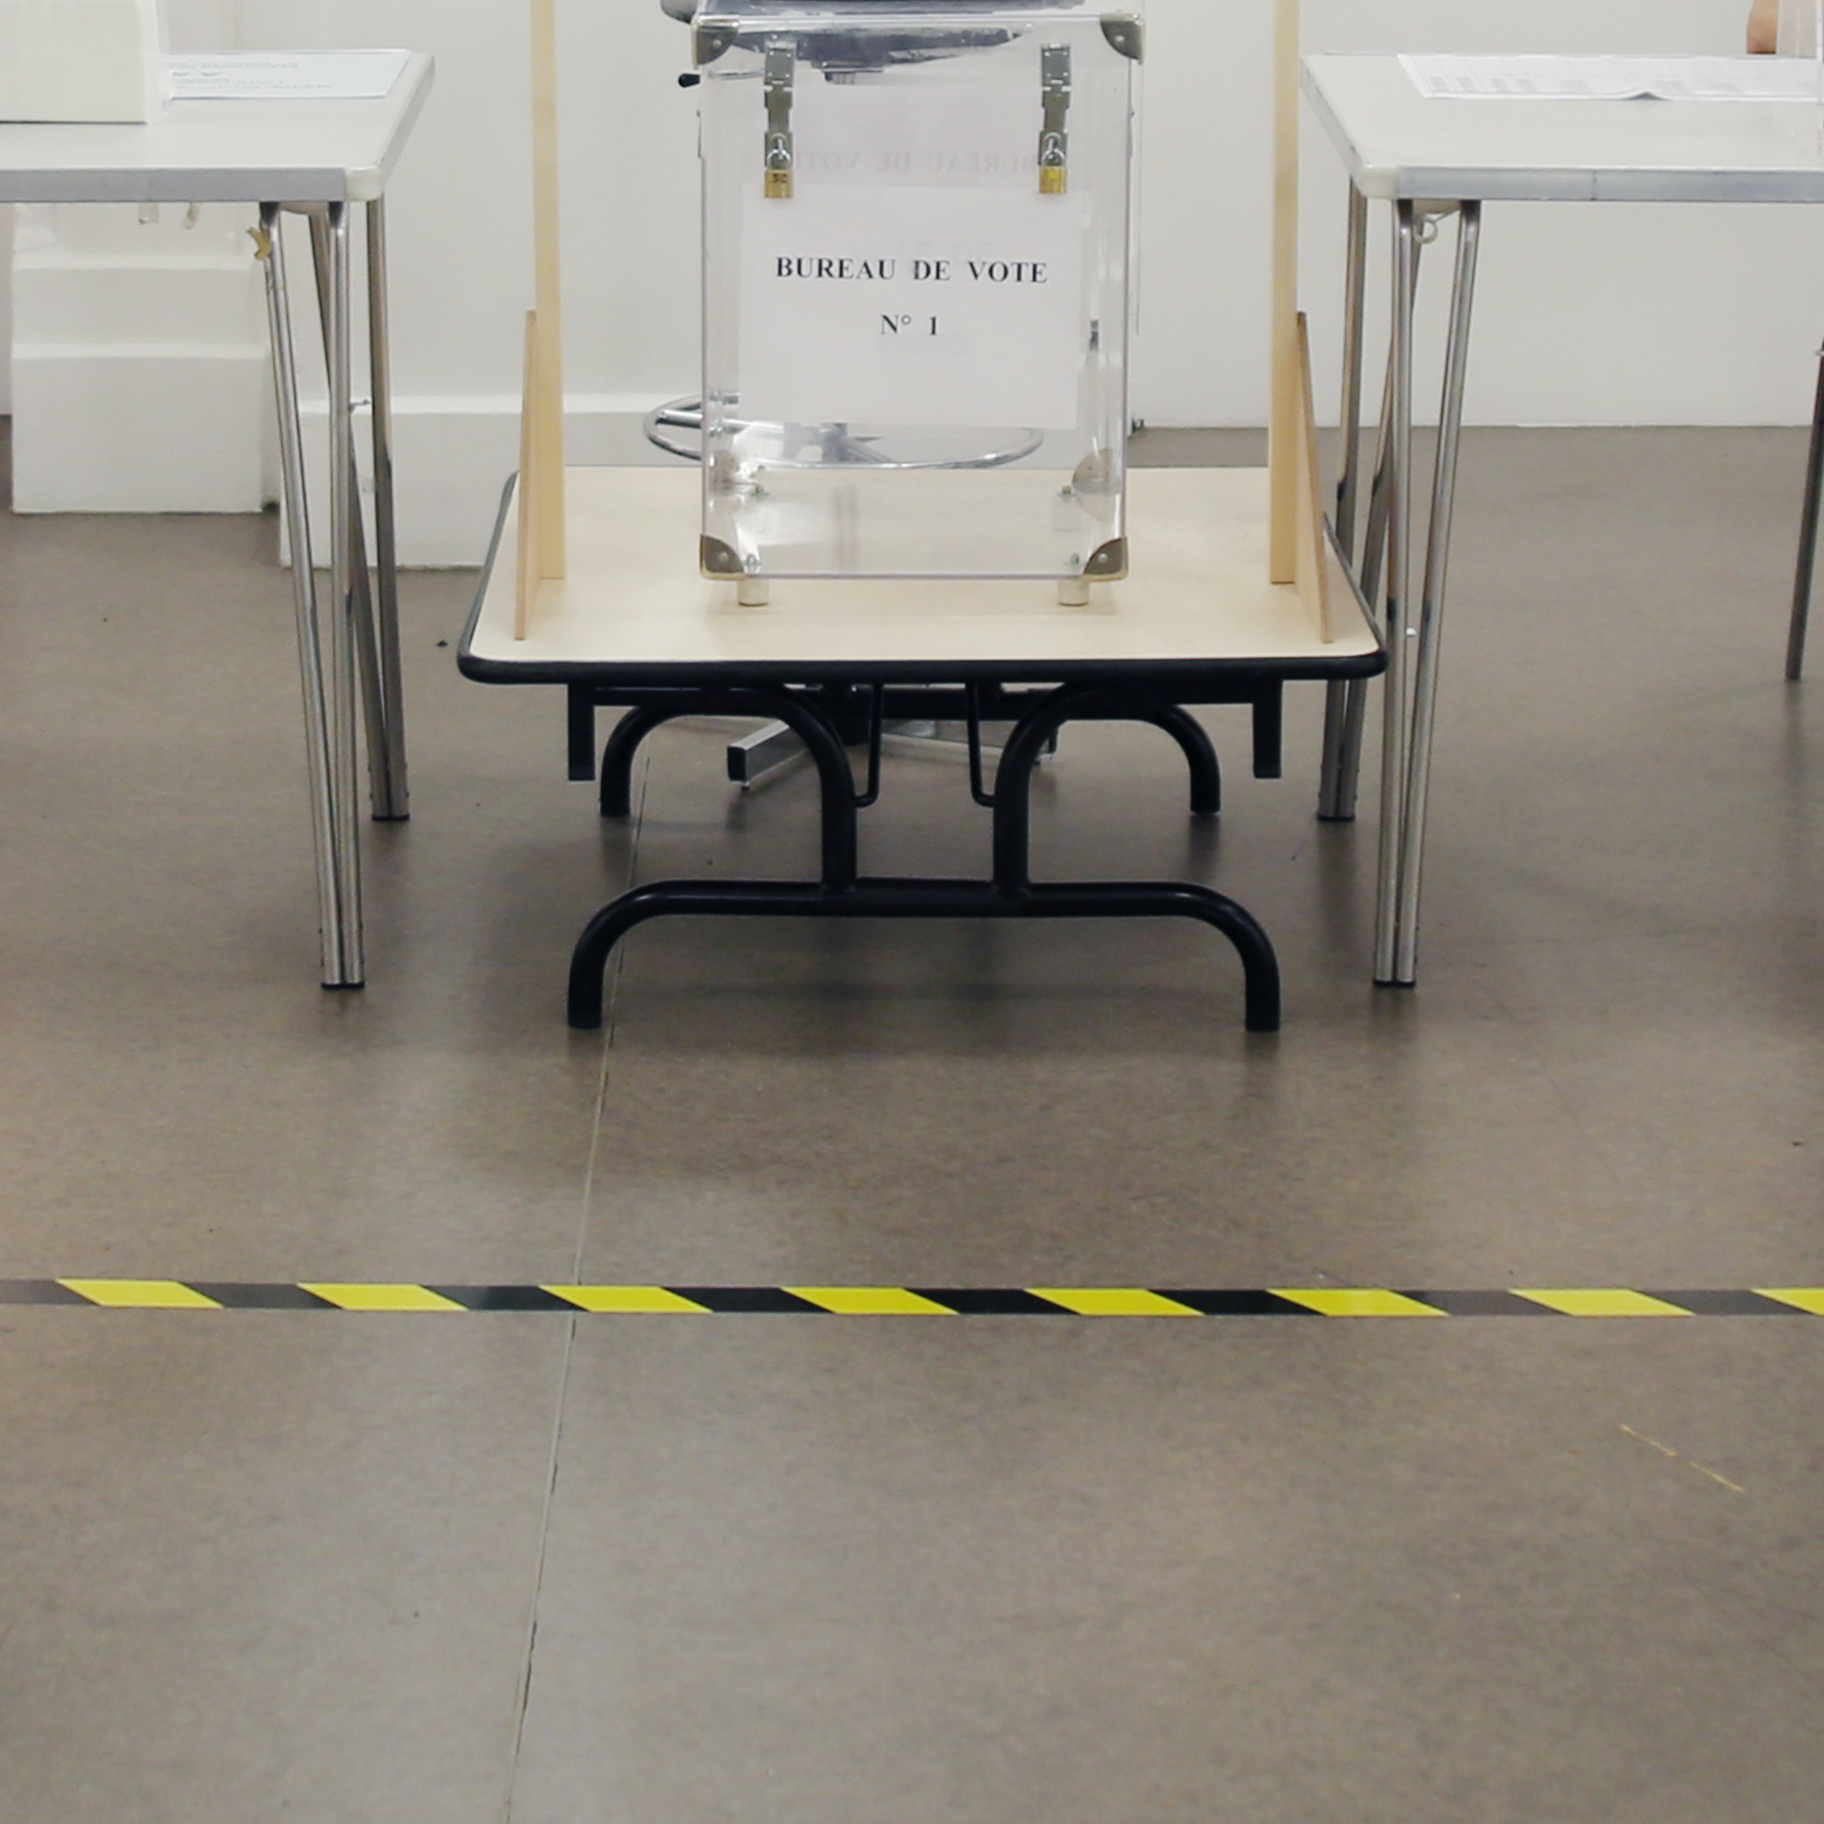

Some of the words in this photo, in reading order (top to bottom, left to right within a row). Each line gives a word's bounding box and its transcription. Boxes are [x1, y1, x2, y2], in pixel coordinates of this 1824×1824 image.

[775, 255, 897, 281] BUREAU
[912, 258, 951, 282] DE
[967, 261, 1048, 285] VOTE
[880, 312, 912, 337] N°
[927, 314, 939, 337] 1
